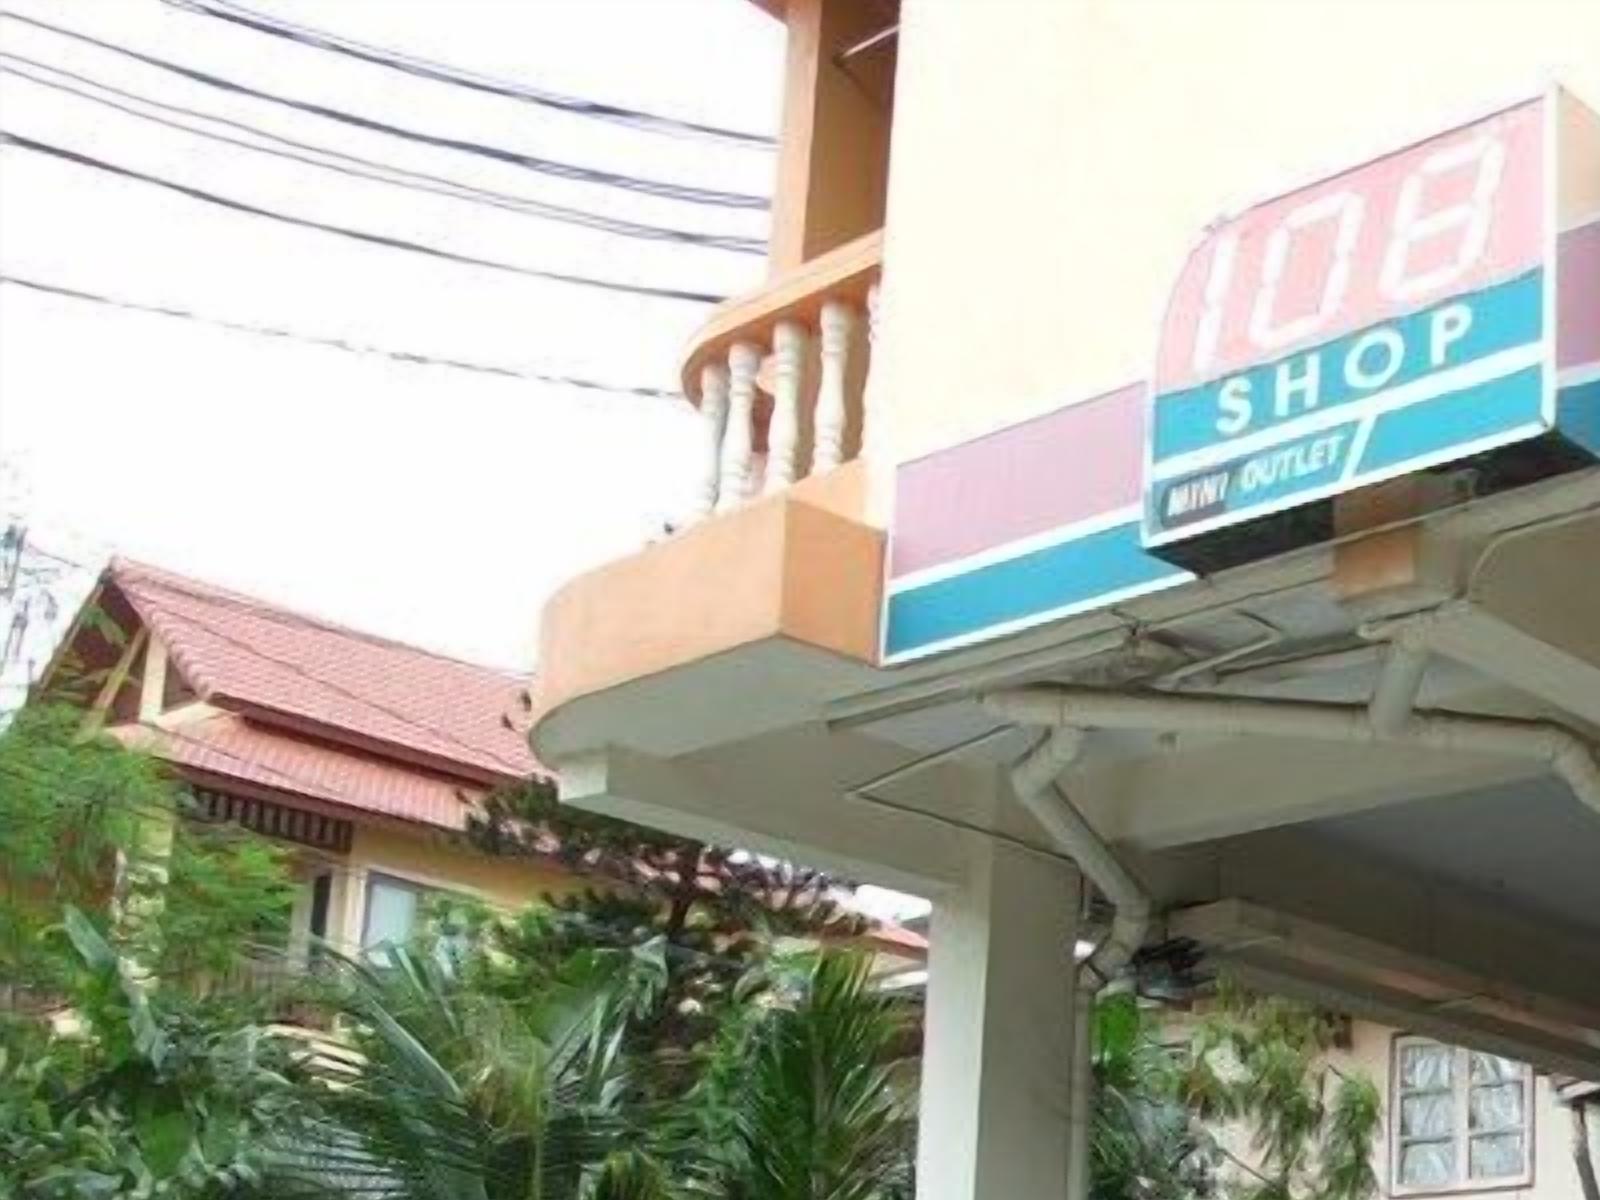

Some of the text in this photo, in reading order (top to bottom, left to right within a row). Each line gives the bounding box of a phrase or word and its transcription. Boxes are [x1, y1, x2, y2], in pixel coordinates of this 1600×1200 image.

[1194, 130, 1506, 372] 108
[1215, 303, 1473, 435] SHOP
[1240, 434, 1345, 492] OUTLET
